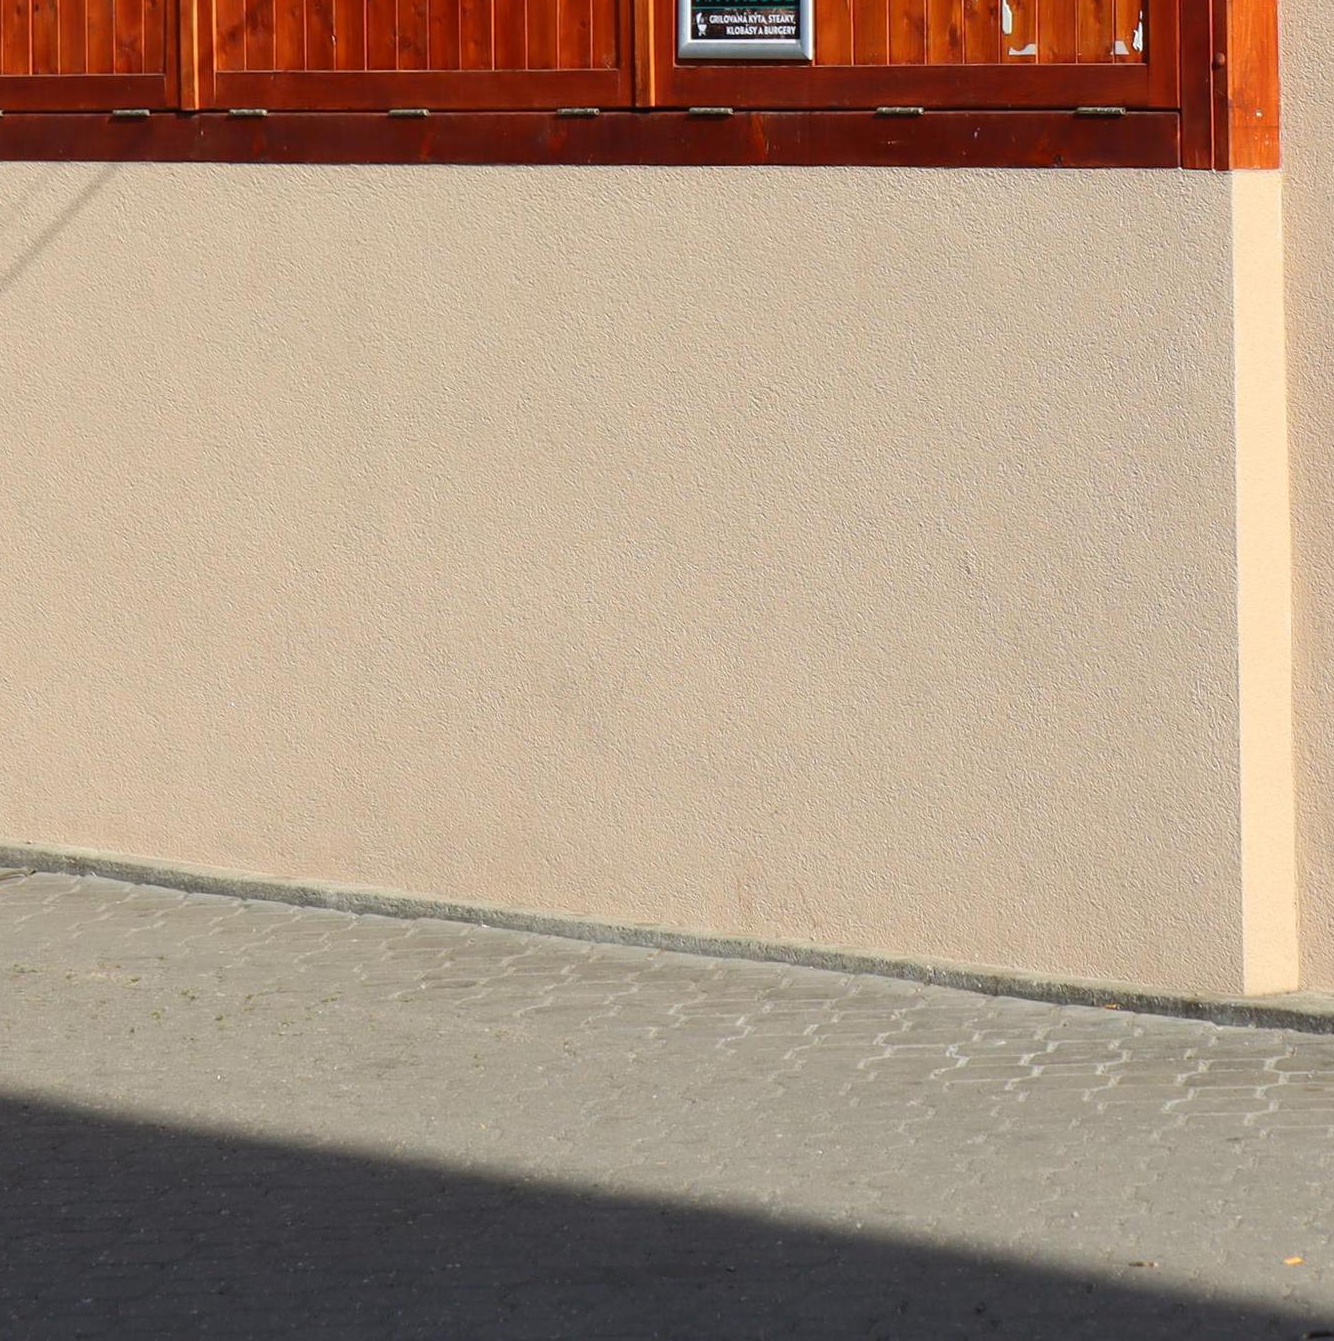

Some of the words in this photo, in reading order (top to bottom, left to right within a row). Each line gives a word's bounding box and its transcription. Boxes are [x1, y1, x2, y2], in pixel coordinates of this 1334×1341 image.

[709, 12, 747, 24] GRILOVANÁ
[768, 14, 796, 25] STEAKY,
[727, 23, 758, 36] KLOBÁSY
[758, 26, 764, 35] A
[764, 25, 796, 36] BURGERY
